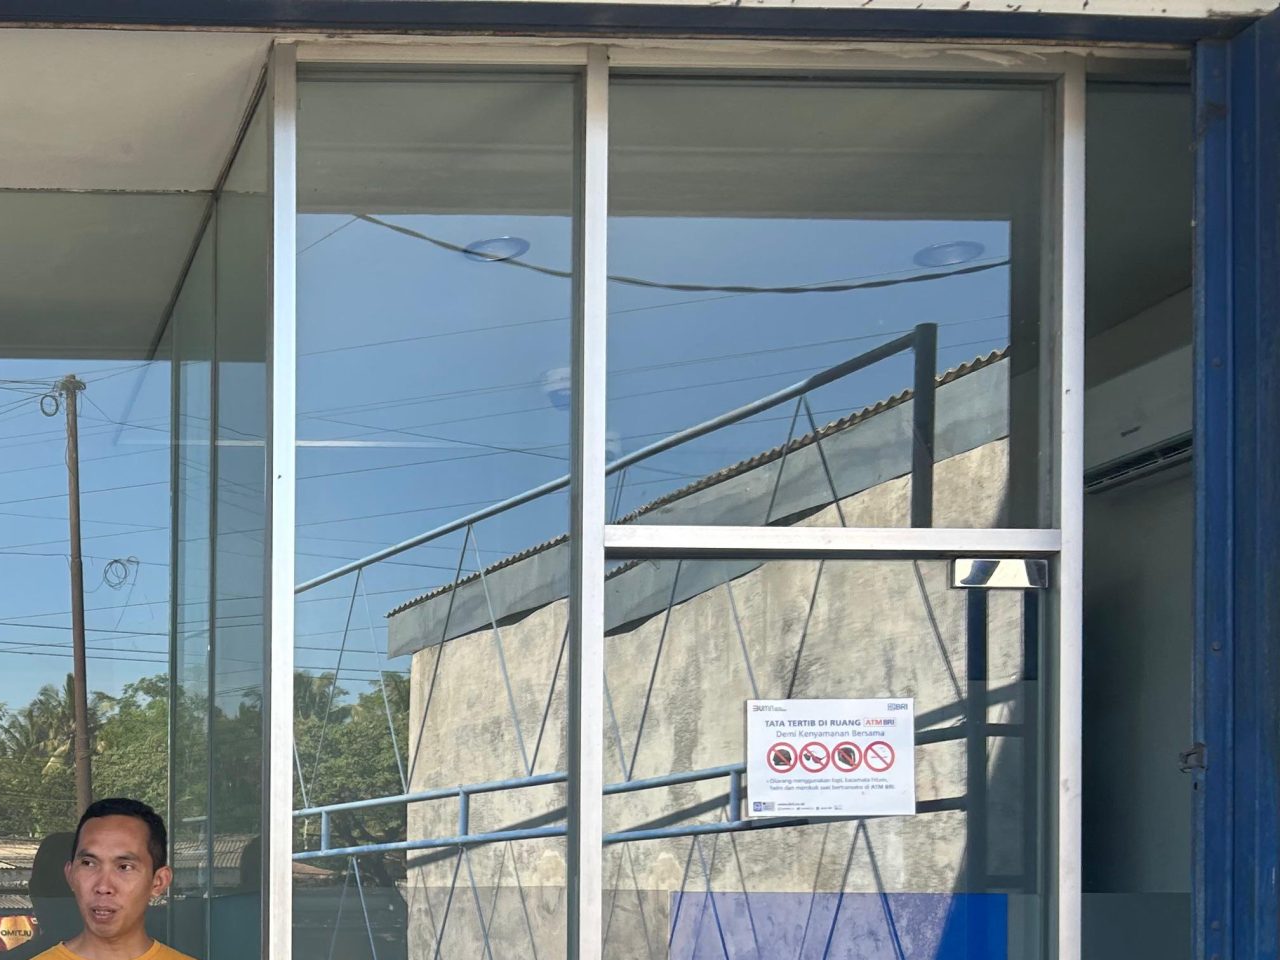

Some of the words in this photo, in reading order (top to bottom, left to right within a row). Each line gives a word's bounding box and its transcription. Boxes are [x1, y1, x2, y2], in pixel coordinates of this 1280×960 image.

[776, 730, 796, 738] Demi
[799, 730, 849, 739] Kenyamanan
[852, 729, 884, 737] Bersama
